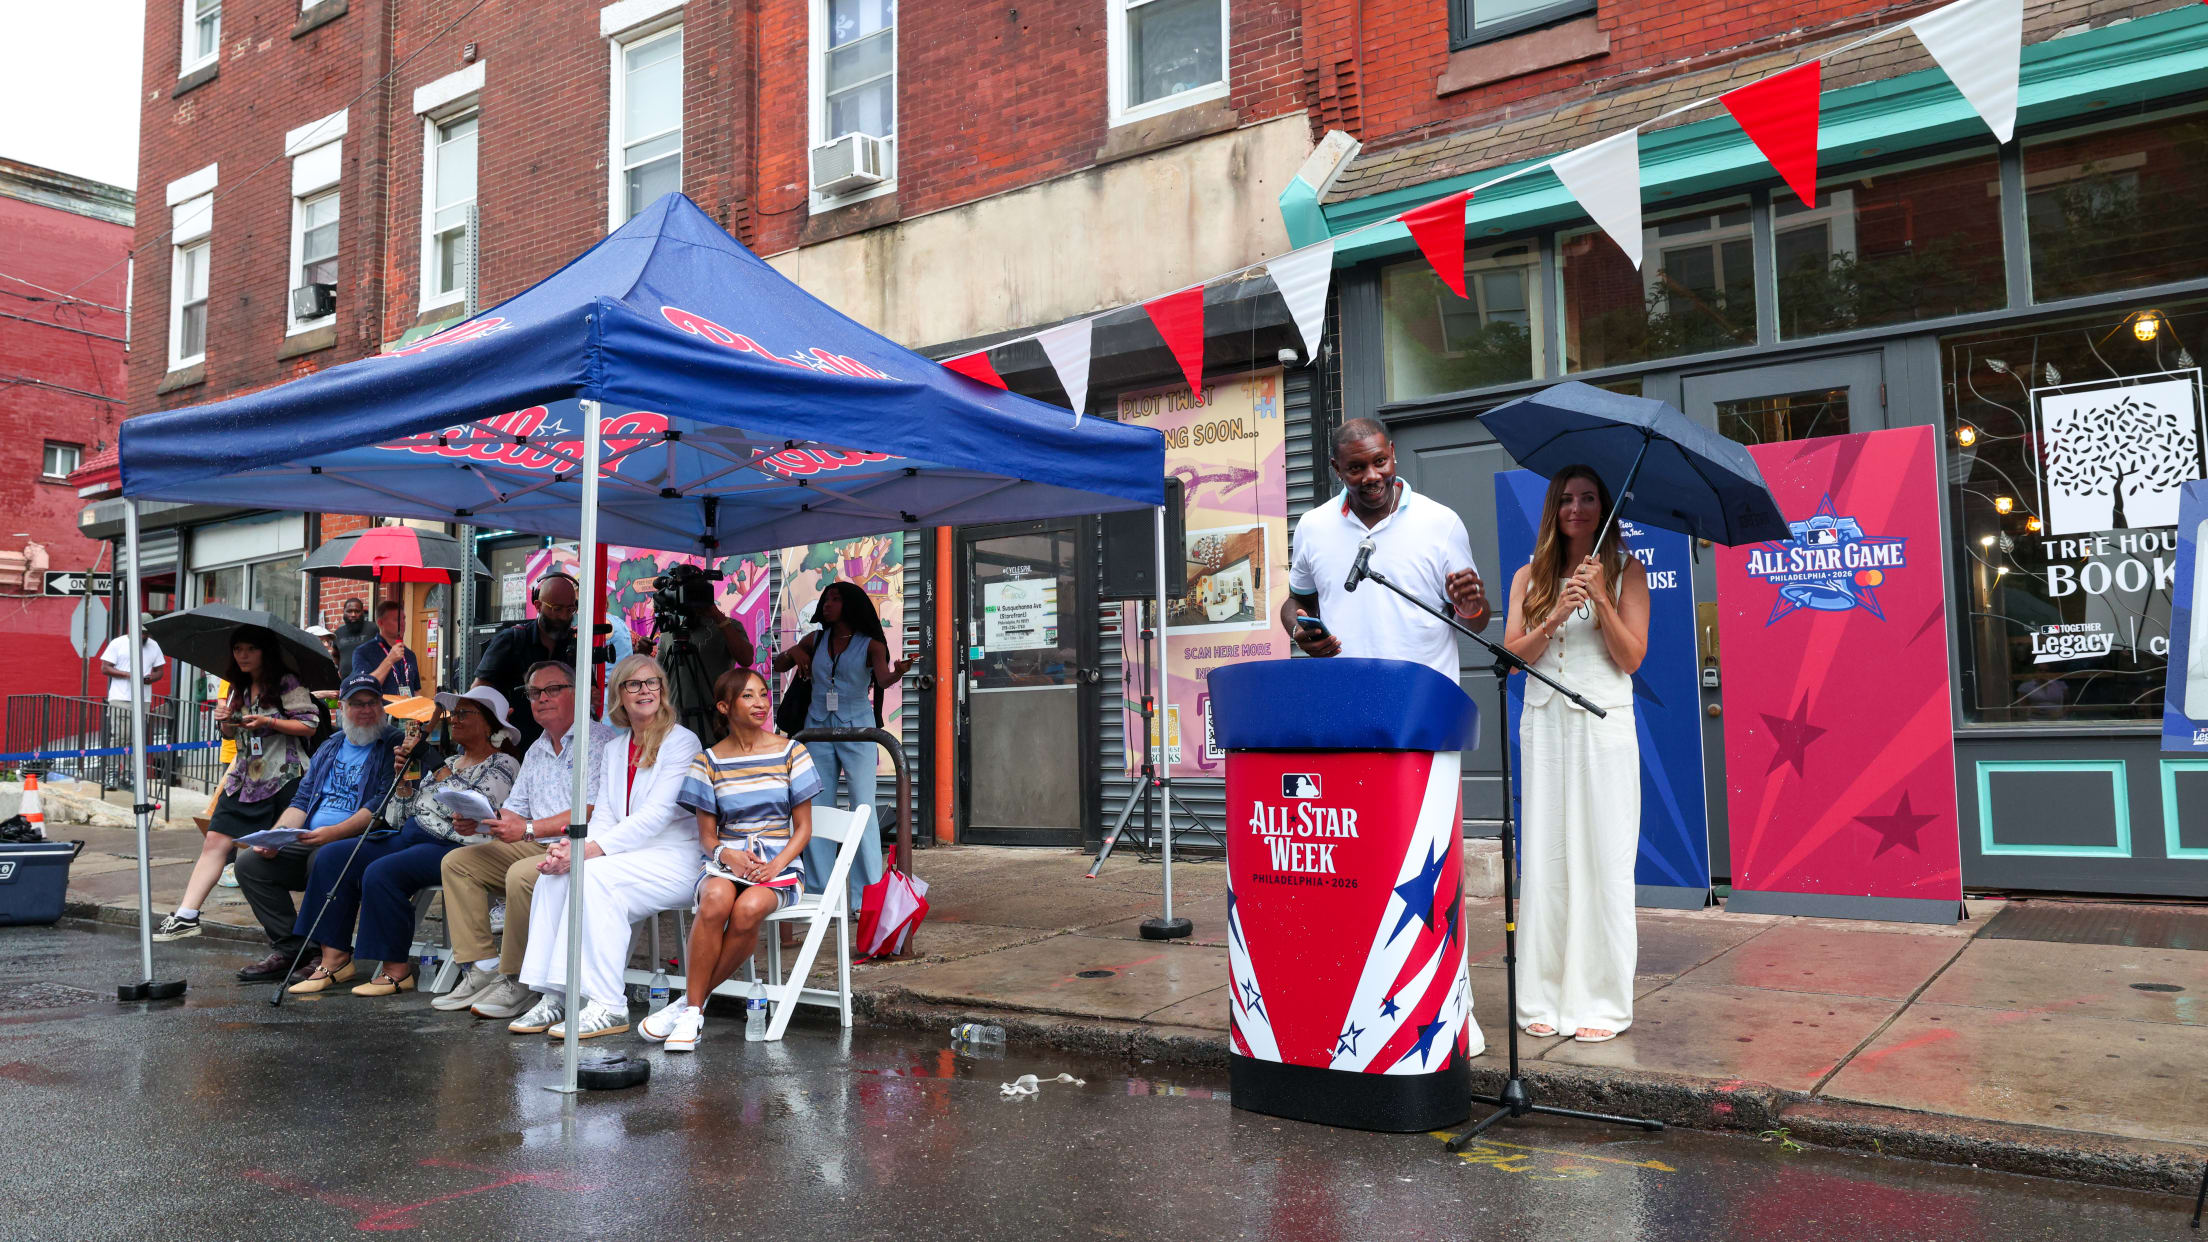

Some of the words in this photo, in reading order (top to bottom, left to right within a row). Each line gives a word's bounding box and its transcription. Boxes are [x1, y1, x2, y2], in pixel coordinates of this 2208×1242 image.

[1121, 394, 1162, 420] PLOT
[1166, 385, 1215, 412] TWIST
[1163, 426, 1189, 450] NG
[1193, 418, 1259, 447] SOON...
[1634, 547, 1655, 566] CY
[2041, 537, 2110, 560] TREE
[2119, 531, 2177, 554] HOU
[1747, 549, 1787, 575] ALL
[1790, 546, 1842, 573] STAR
[1844, 543, 1904, 568] GAME
[70, 579, 87, 589] ON
[97, 580, 112, 589] WA
[1646, 570, 1677, 590] USE
[1770, 572, 1827, 582] PHILADELPHIA
[1832, 570, 1853, 578] 2026
[2047, 557, 2176, 597] BOOK
[2060, 622, 2102, 633] TOGETHER
[1184, 647, 1212, 660] SCAN
[1213, 644, 1240, 659] HERE
[1241, 642, 1272, 657] MORE
[2030, 632, 2114, 658] Legacy
[1248, 800, 1294, 836] ALL
[1297, 801, 1360, 838] STAR
[1263, 836, 1338, 874] WEEK
[1252, 874, 1324, 887] PHILADELPHIA
[1331, 877, 1358, 889] 2026
